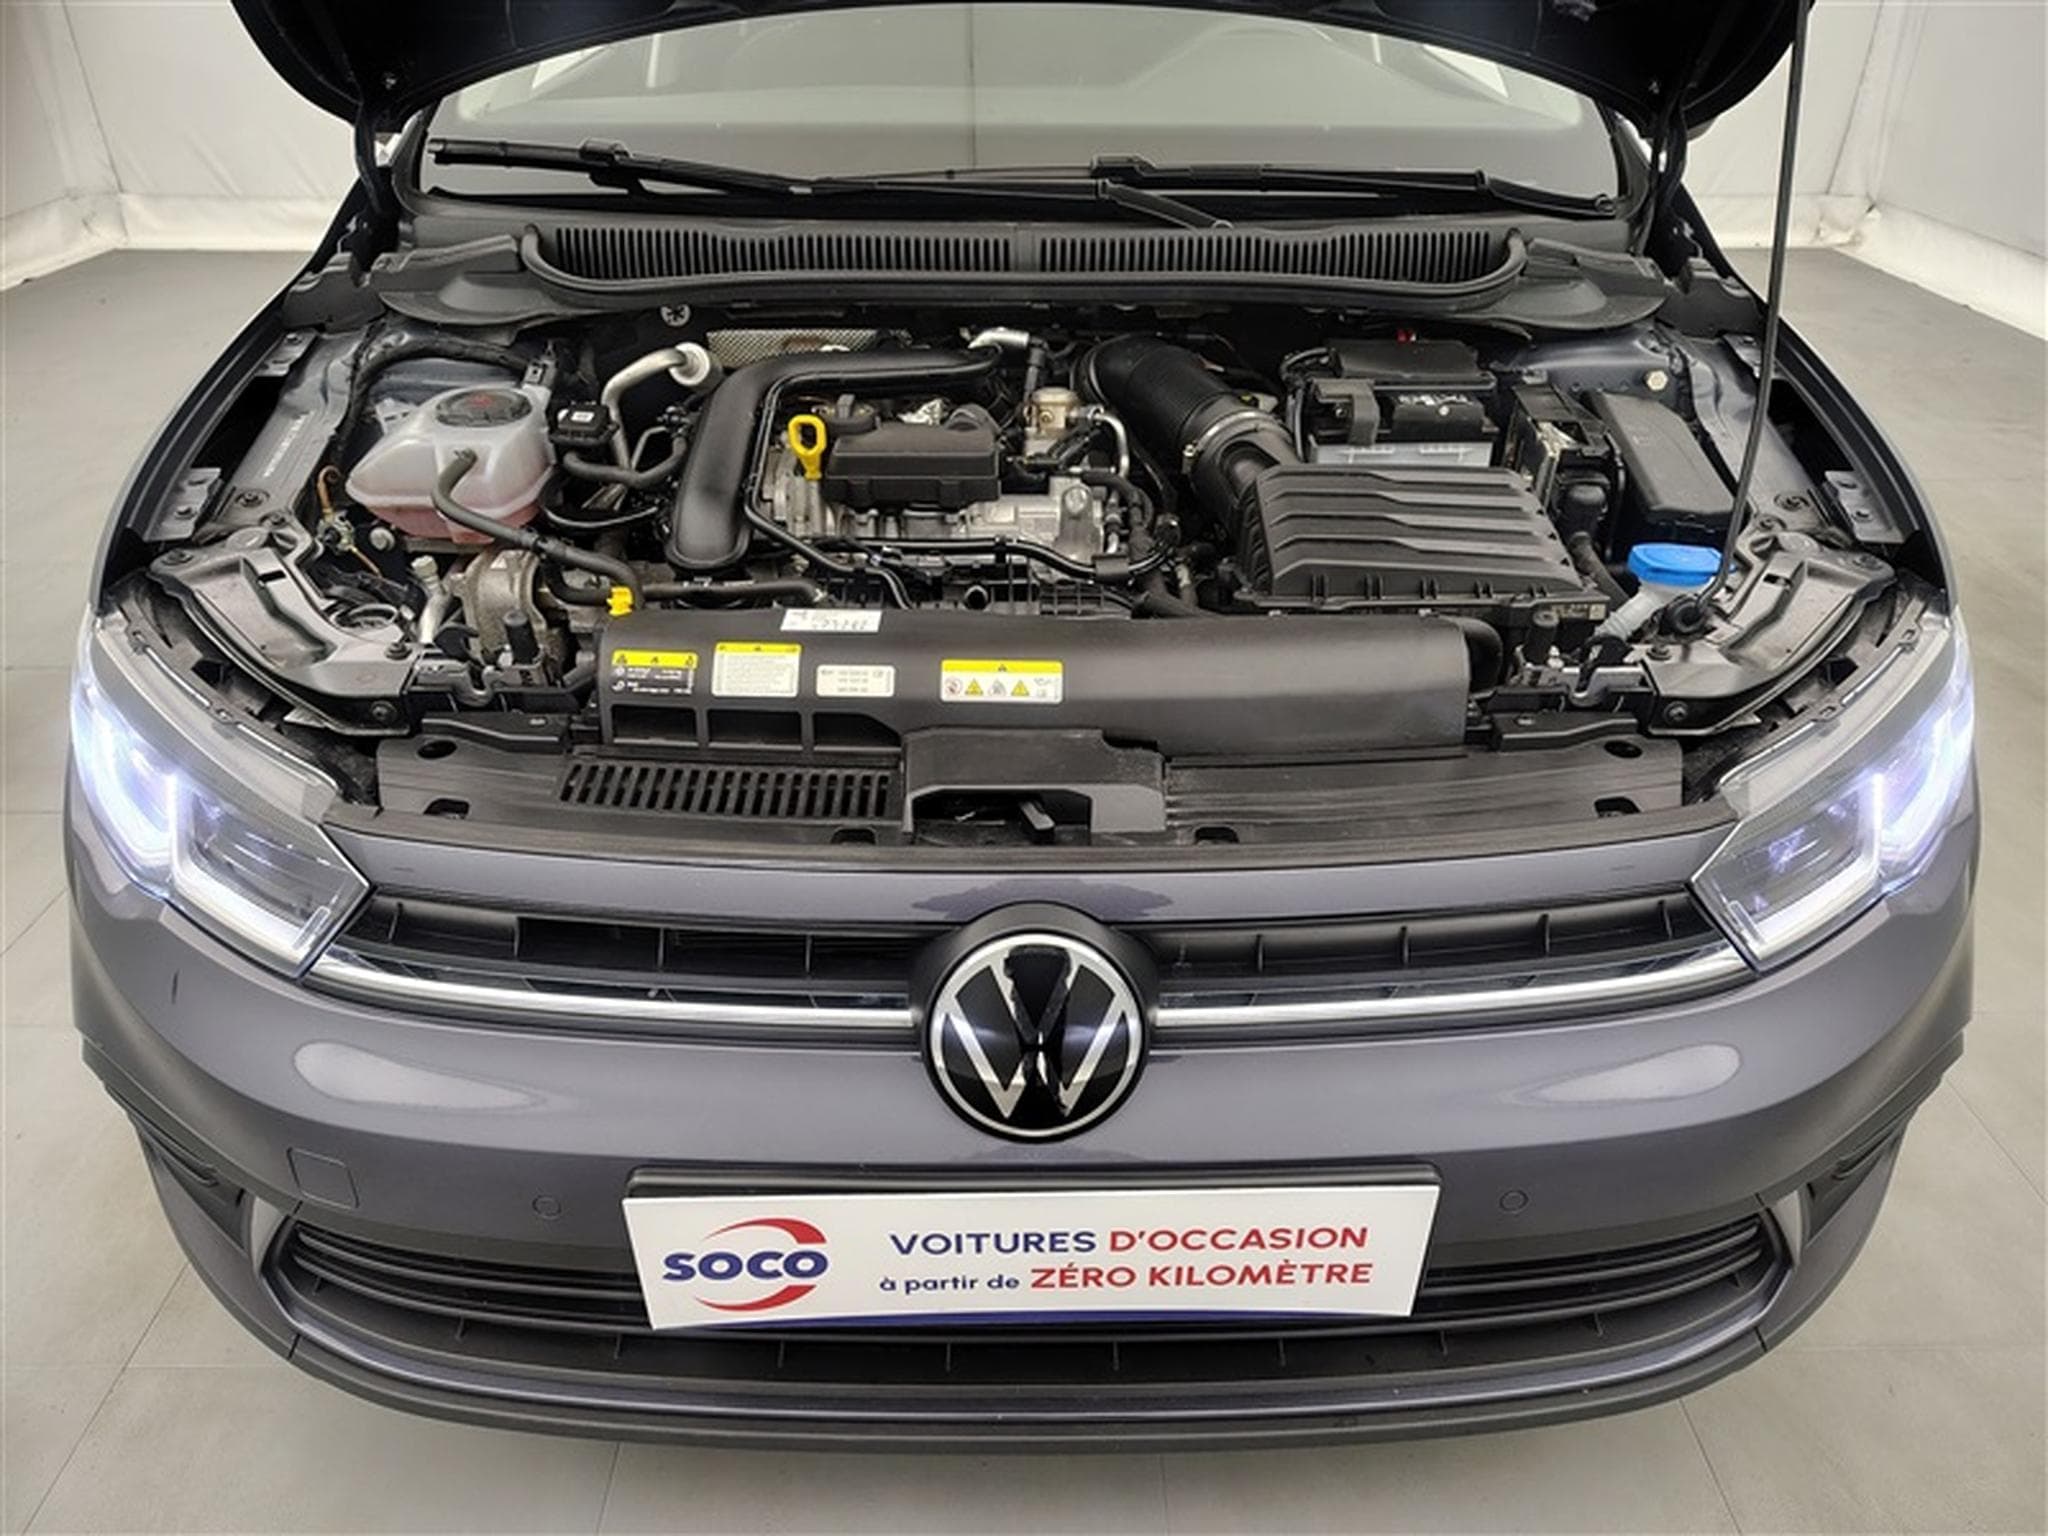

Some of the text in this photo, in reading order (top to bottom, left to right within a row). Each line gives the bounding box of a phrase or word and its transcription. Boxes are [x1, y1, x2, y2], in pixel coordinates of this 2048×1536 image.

[889, 1226, 1369, 1256] VOITURES D'OCCASION
[662, 1250, 829, 1281] SOCO
[879, 1258, 1374, 1296] à partir de ZÉRO KILOMÈTRE
